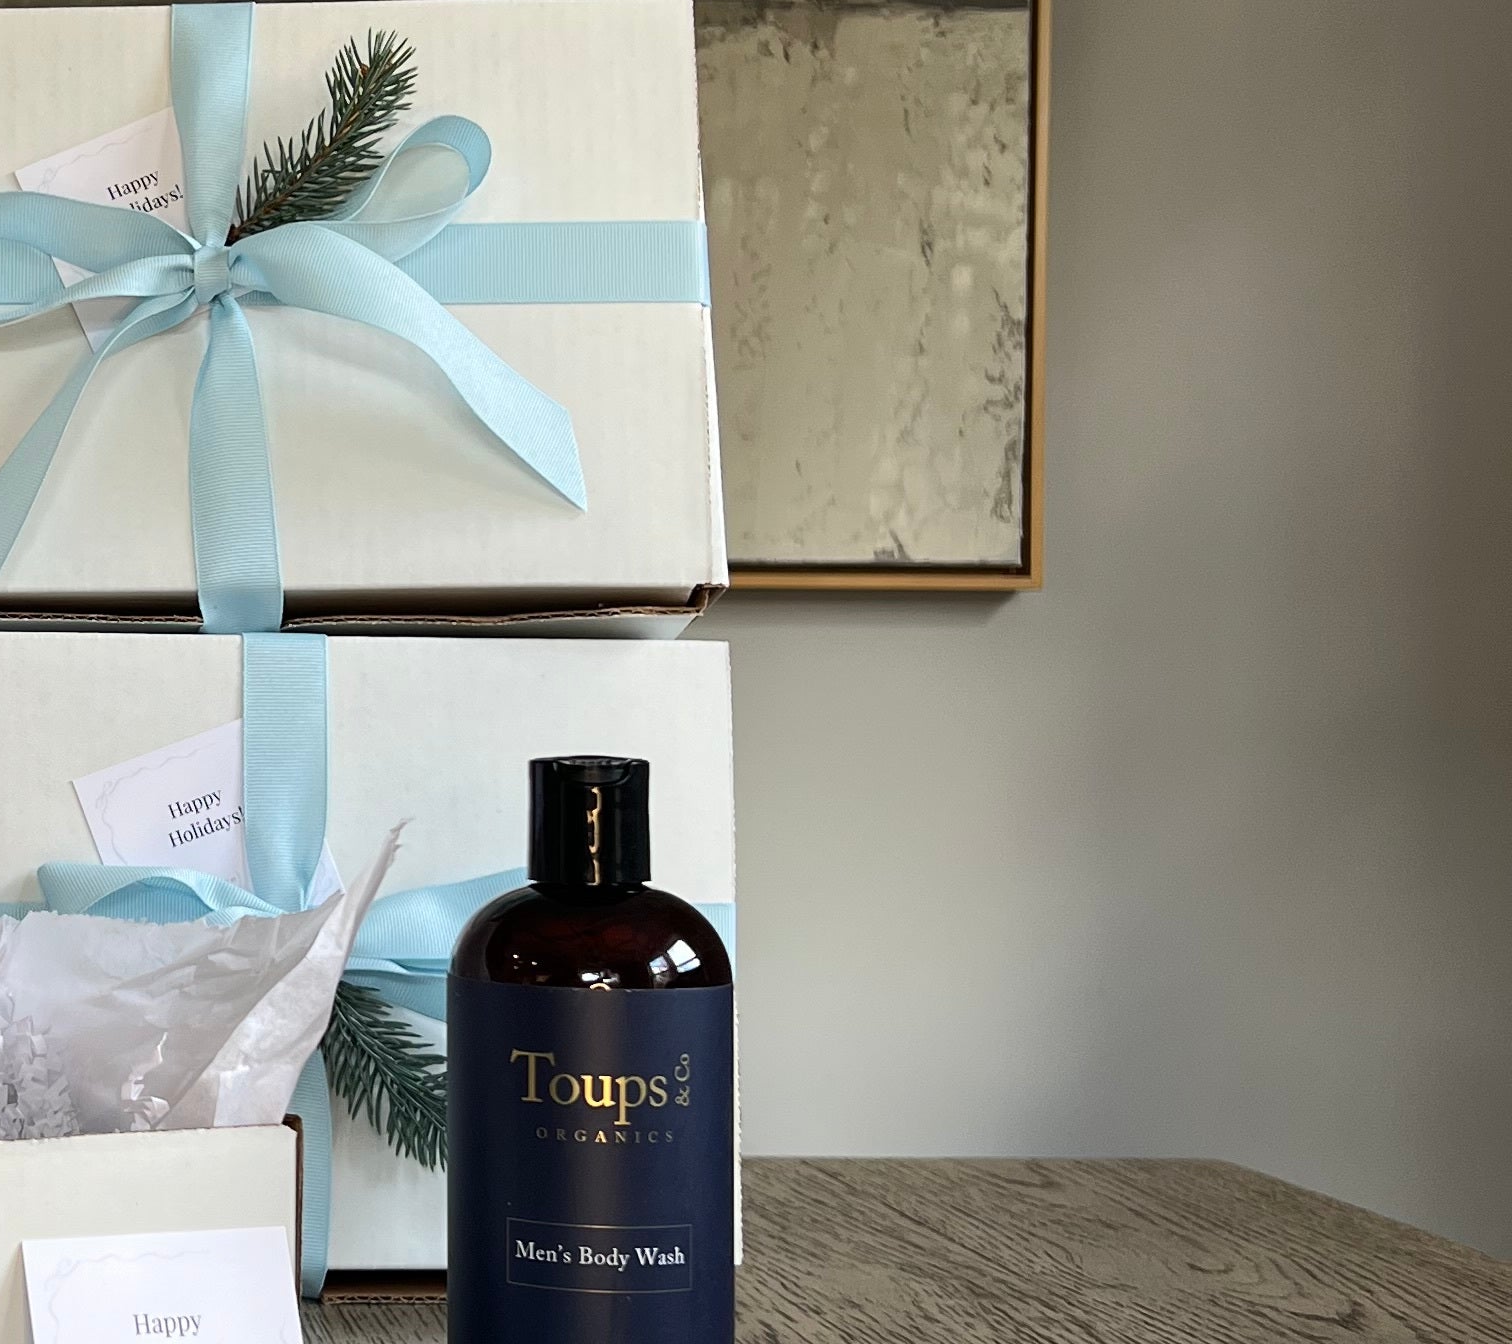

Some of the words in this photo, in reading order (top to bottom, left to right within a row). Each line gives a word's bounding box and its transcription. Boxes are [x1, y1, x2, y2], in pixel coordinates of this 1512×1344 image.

[107, 170, 159, 200] Happy
[168, 789, 222, 820] Happy
[168, 805, 245, 847] Holidays!
[510, 1048, 668, 1126] Toups
[536, 1127, 674, 1144] ORGANICS
[515, 1240, 571, 1264] Men's
[578, 1246, 630, 1272] Body
[635, 1246, 686, 1266] Wash
[132, 1313, 202, 1338] Happy
